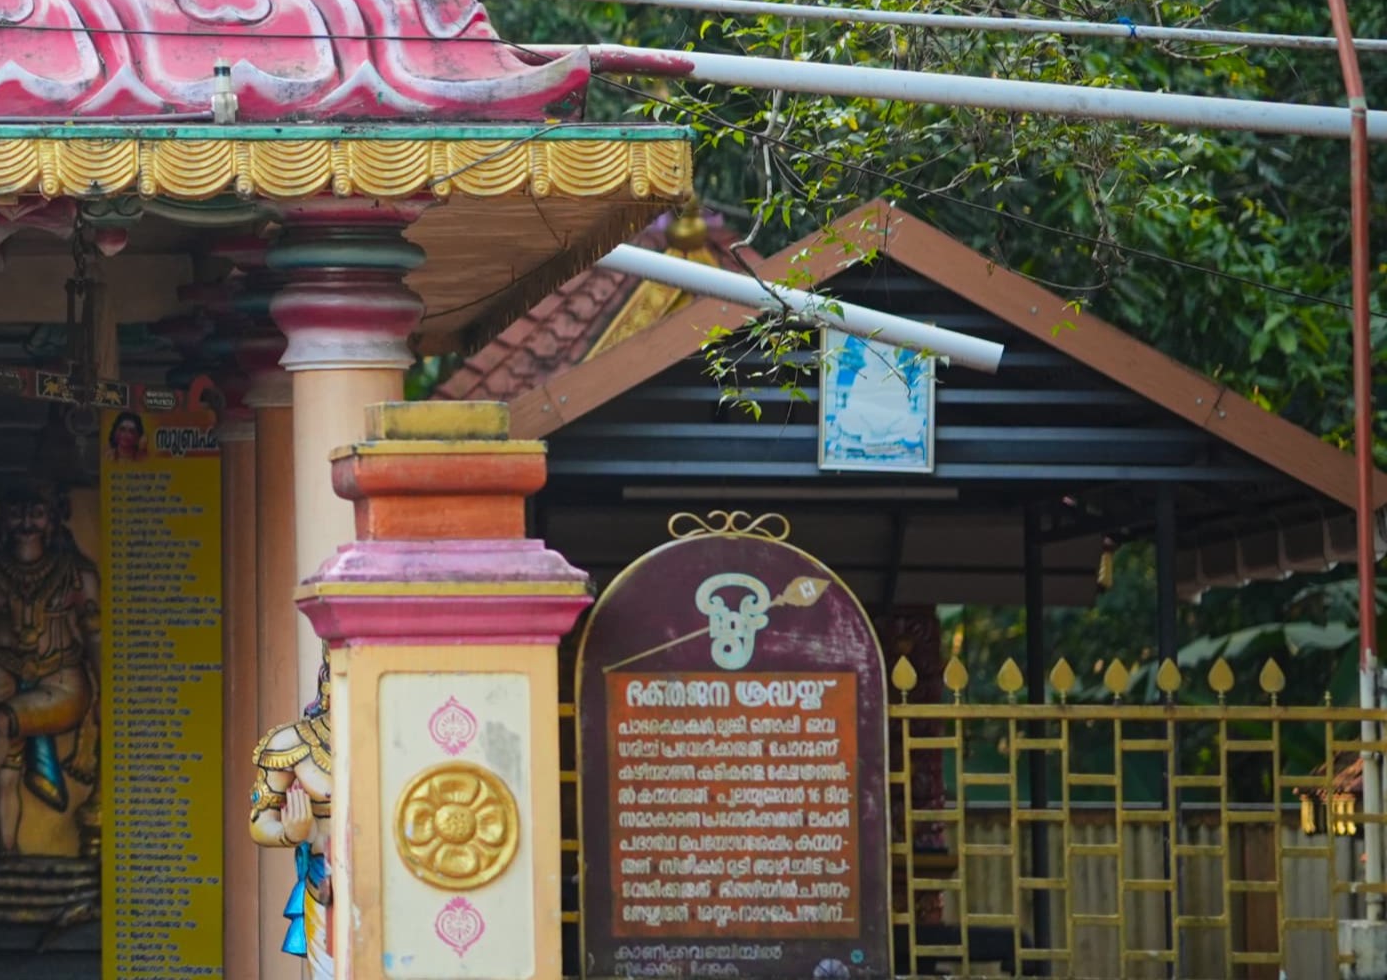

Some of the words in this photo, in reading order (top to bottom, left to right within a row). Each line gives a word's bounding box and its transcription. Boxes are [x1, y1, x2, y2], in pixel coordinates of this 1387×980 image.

[805, 717, 836, 735] ഇവ
[807, 786, 821, 804] 16
[808, 808, 850, 828] ലഹരി
